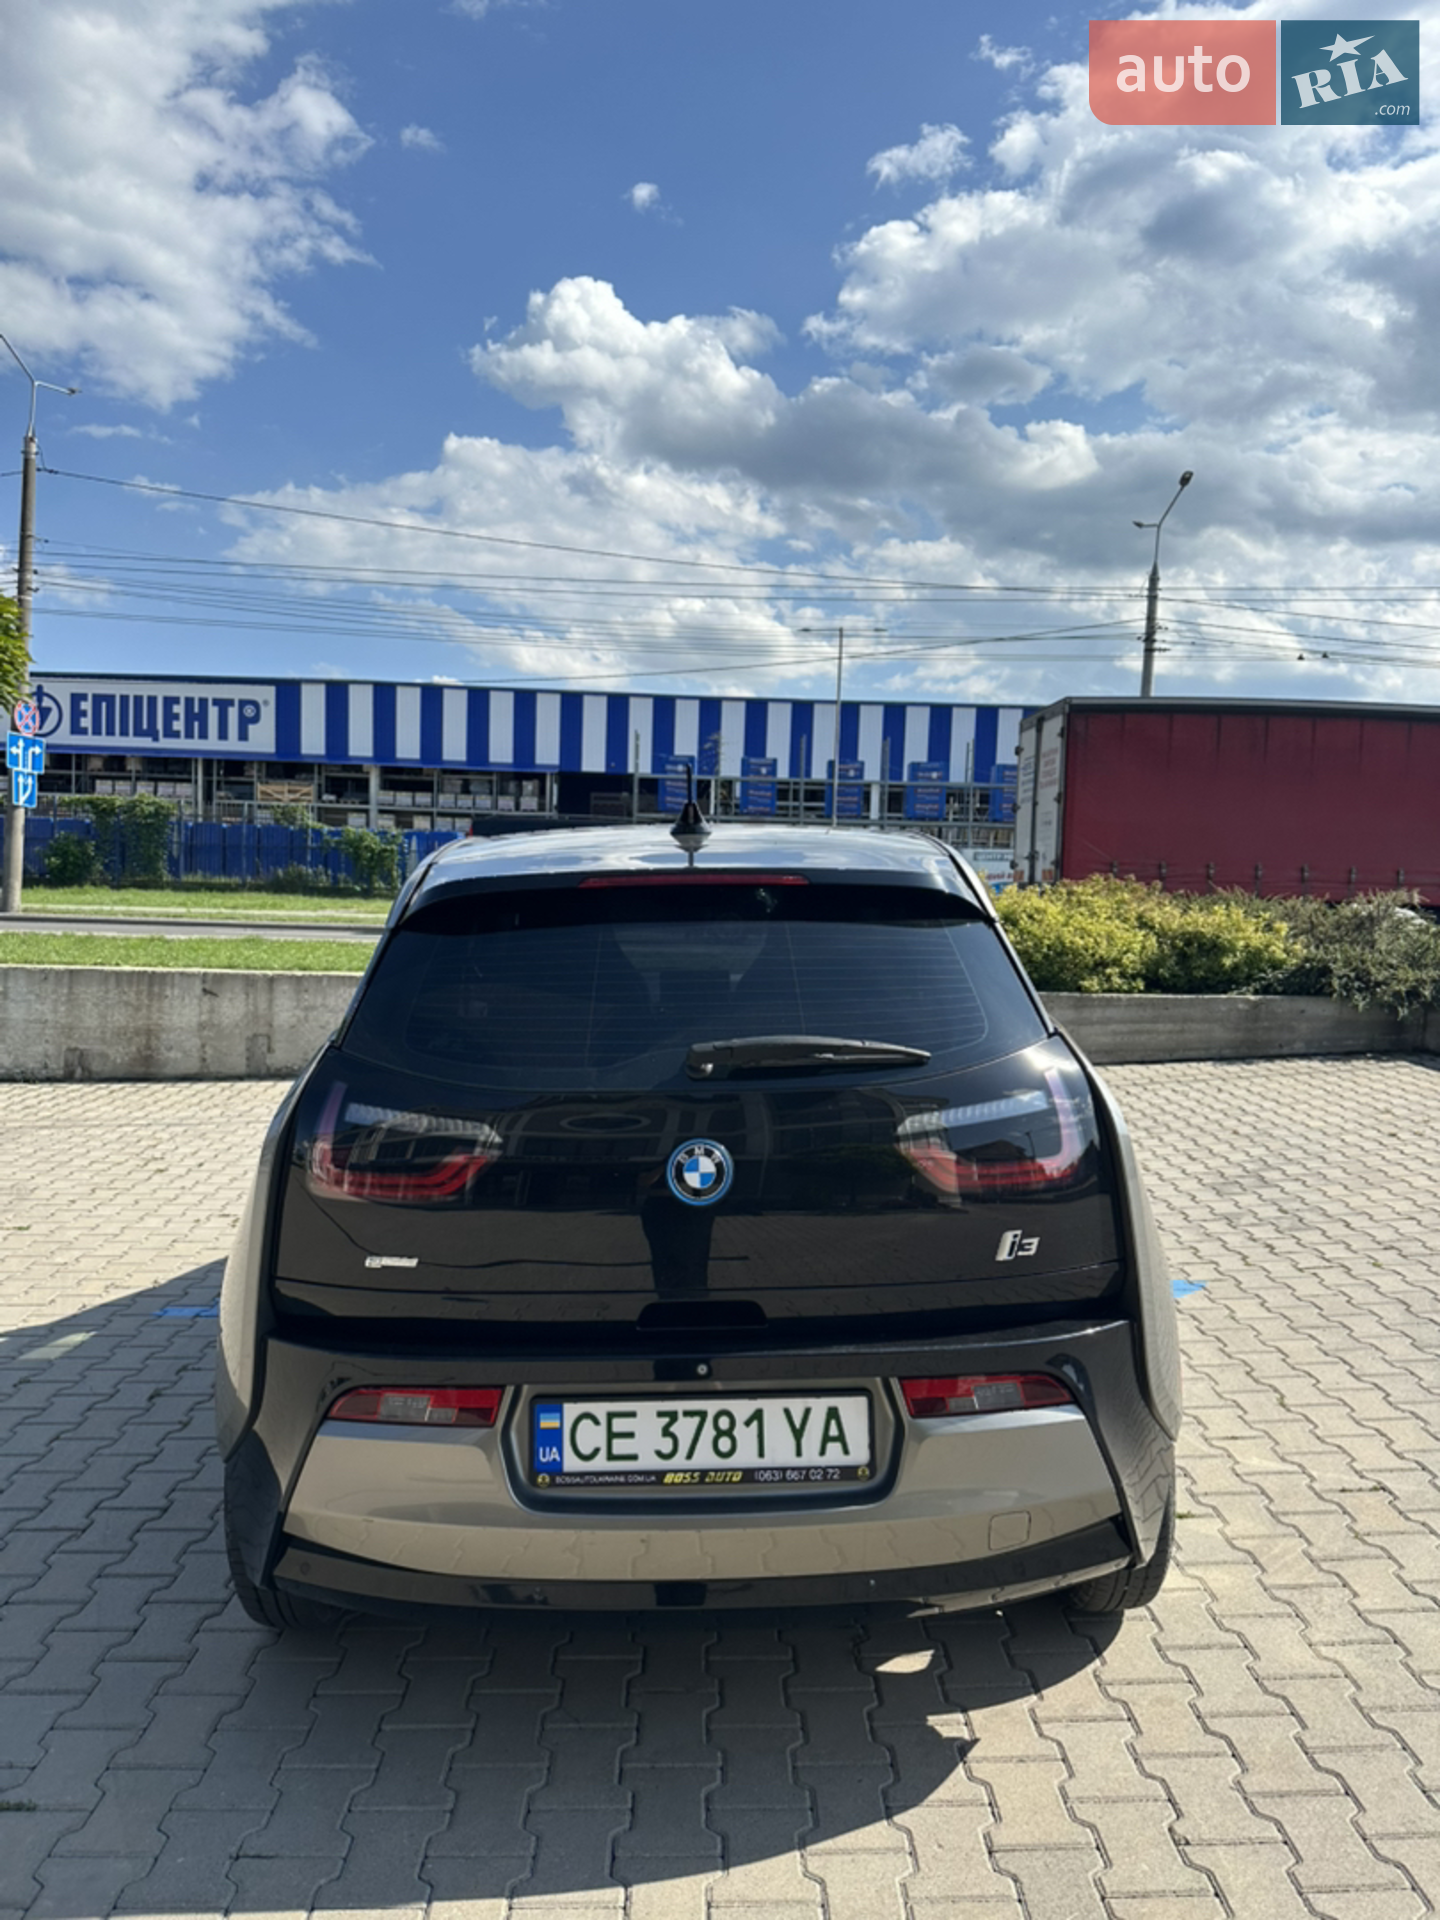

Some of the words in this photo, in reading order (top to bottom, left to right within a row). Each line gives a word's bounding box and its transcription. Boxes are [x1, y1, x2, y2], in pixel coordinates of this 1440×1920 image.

[70, 692, 261, 742] ЕПІЦЕНТР
[676, 1143, 722, 1164] BMW
[995, 1229, 1041, 1261] i3
[569, 1410, 639, 1462] CE
[654, 1407, 765, 1461] 3781
[783, 1405, 850, 1458] YA
[539, 1447, 560, 1463] UA
[663, 1471, 700, 1484] BOSS
[754, 1468, 783, 1482] (063)
[785, 1468, 806, 1481] 667
[809, 1468, 823, 1481] 02
[826, 1467, 841, 1480] 72
